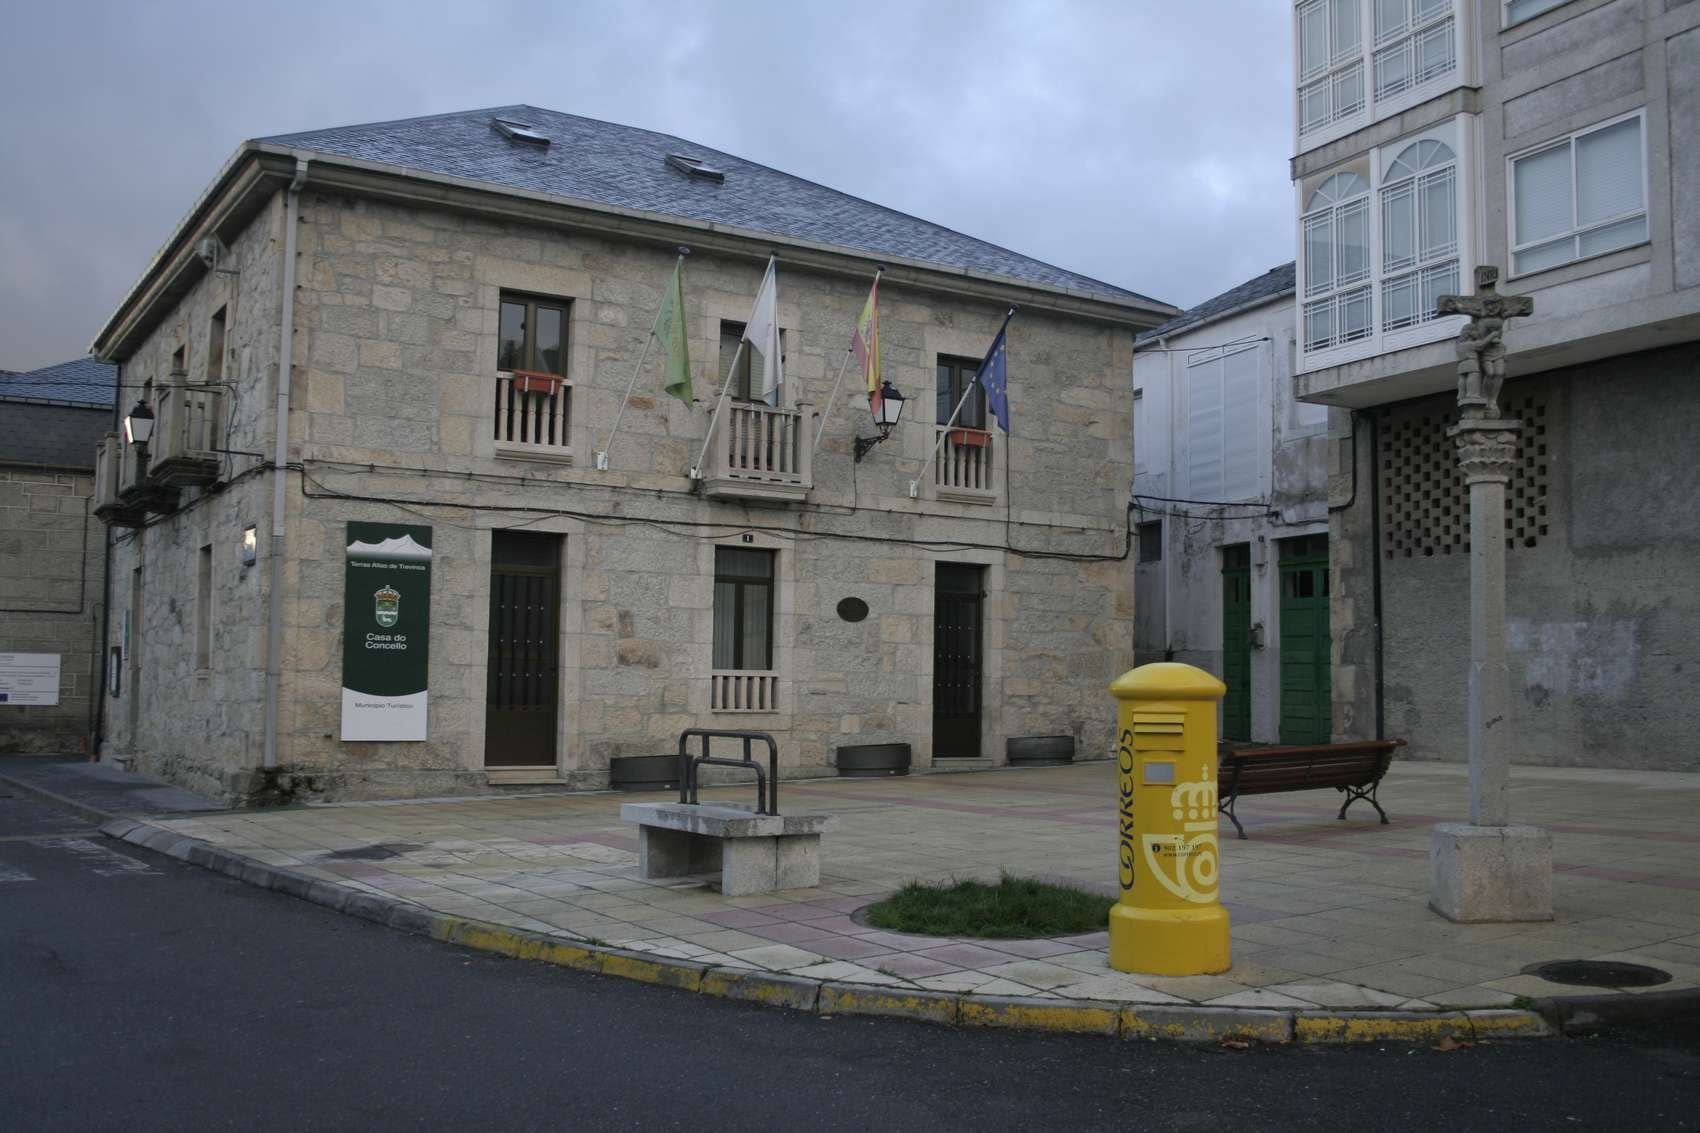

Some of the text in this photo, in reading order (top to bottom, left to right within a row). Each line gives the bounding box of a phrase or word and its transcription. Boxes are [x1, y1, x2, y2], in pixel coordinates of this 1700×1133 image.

[366, 632, 407, 642] Casa do
[365, 641, 407, 650] Concello
[1119, 728, 1135, 891] CORREOS
